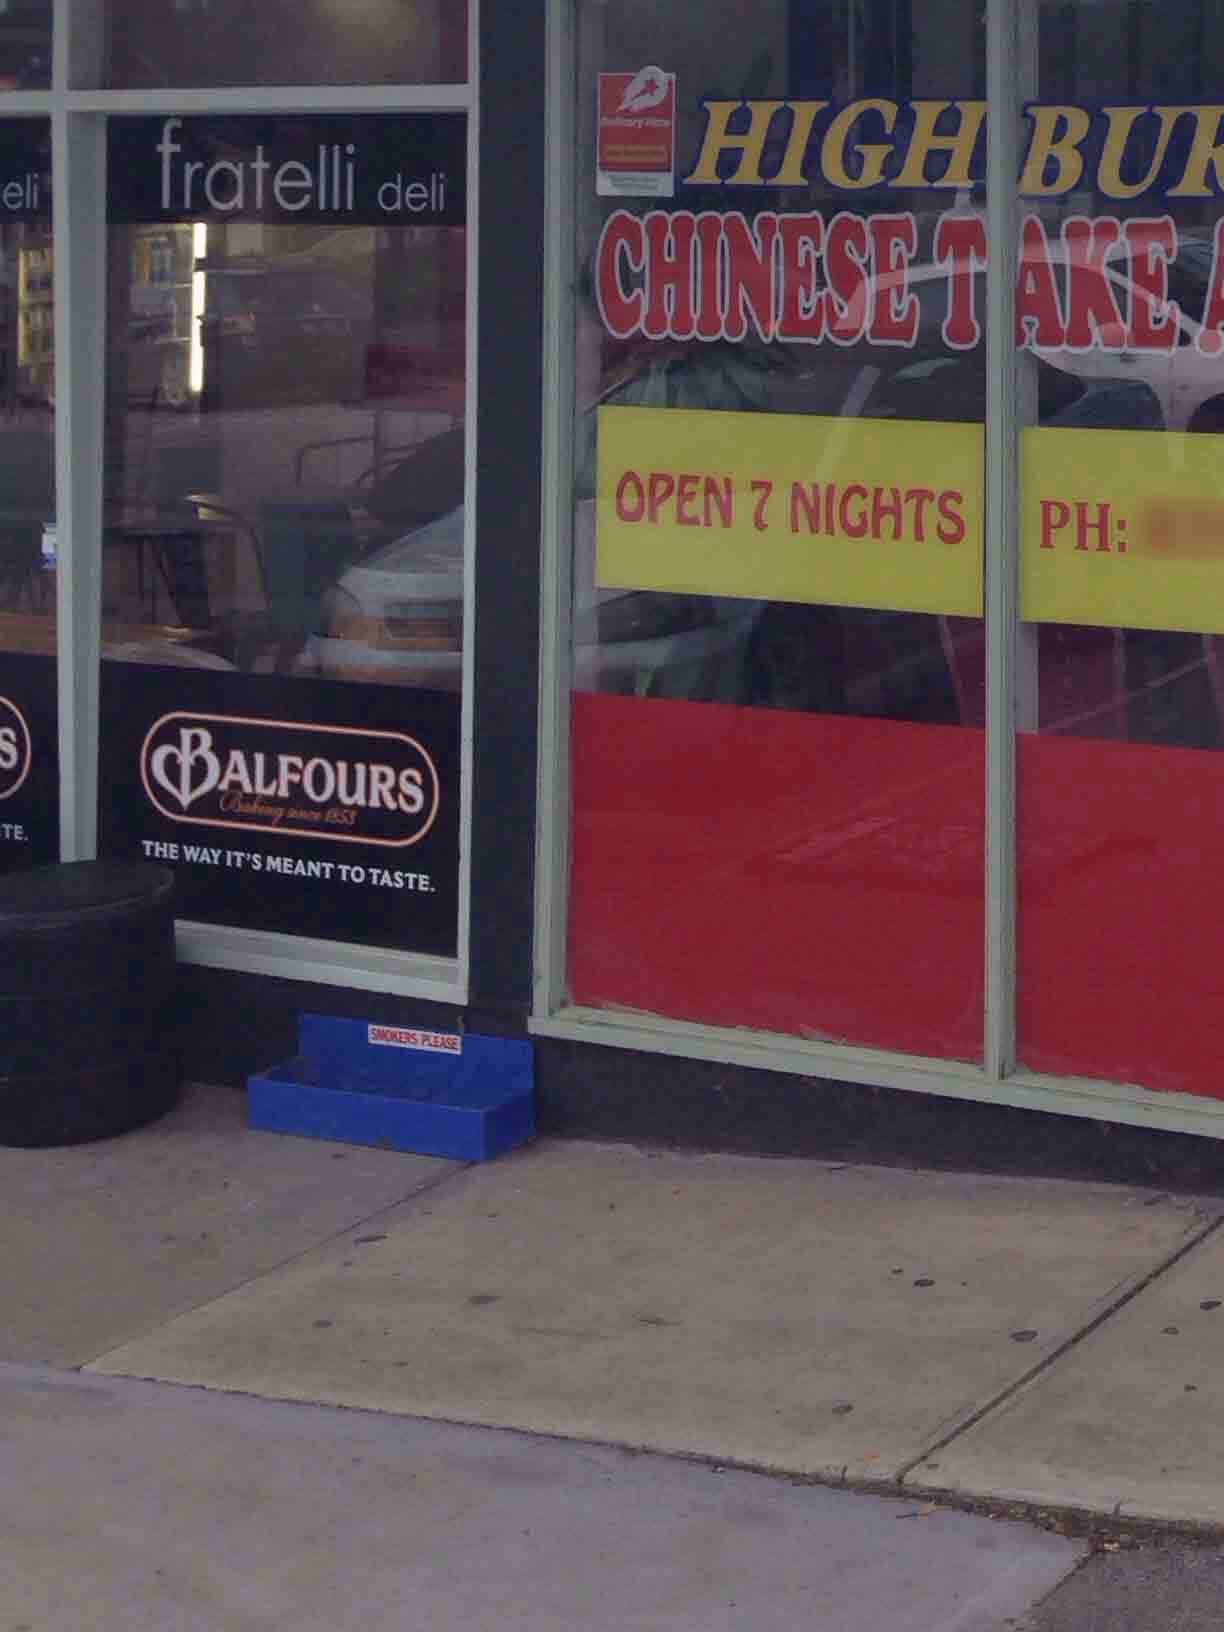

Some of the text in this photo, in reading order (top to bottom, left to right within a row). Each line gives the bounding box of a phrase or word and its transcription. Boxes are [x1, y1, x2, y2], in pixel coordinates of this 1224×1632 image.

[1, 171, 40, 211] eli
[155, 117, 447, 212] fratelli deli
[596, 209, 920, 348] CHINESE
[615, 470, 967, 545] OPEN 7 NIGHTS
[1039, 500, 1128, 553] PH:
[150, 727, 425, 814] BALFOURS
[142, 839, 437, 893] THE WAY IT'S MEANT TO TASTE.
[371, 1027, 459, 1051] SMOKERS PLEASE
